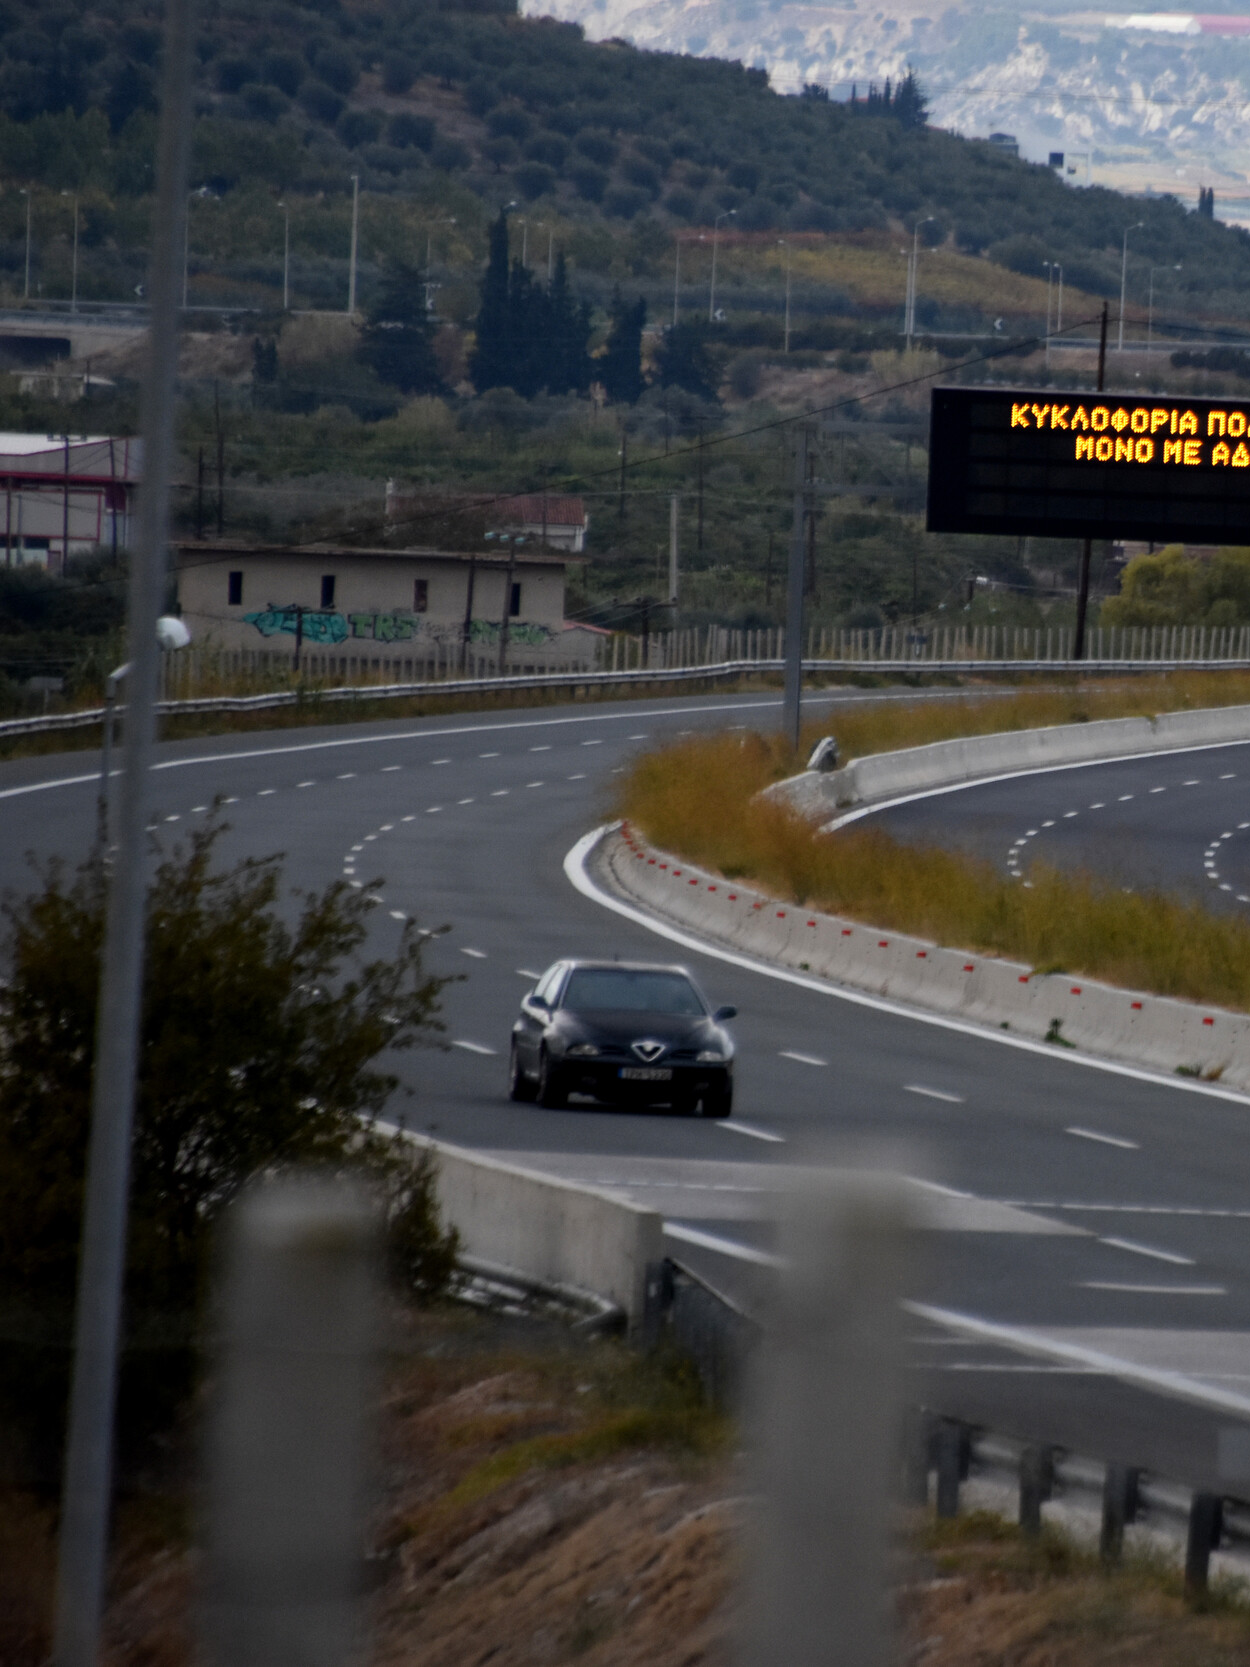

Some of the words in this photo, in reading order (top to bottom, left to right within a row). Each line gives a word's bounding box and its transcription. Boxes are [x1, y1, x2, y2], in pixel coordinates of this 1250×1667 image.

[1010, 402, 1198, 434] ΚΥΚΛΟΦΟΡΙΑ
[1075, 435, 1154, 463] ΜΟΝΟ
[1163, 439, 1202, 465] ΜΕ
